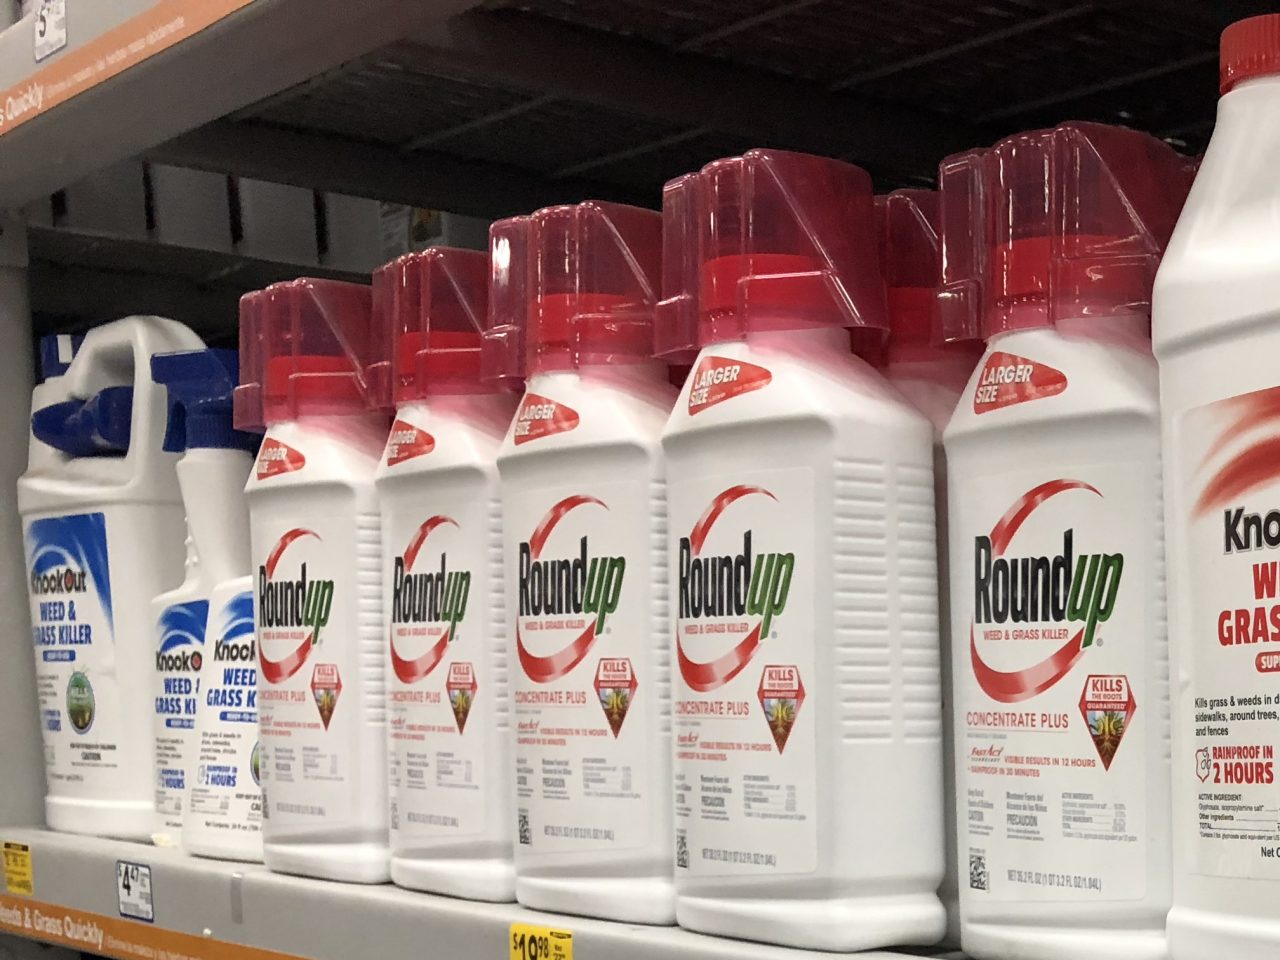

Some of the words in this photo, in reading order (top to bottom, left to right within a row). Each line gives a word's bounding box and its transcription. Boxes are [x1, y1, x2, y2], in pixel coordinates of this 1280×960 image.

[694, 364, 740, 390] LARGER
[982, 366, 1034, 386] LARGER
[690, 389, 709, 408] SIZE
[976, 386, 998, 404] SIZE
[519, 536, 626, 637] Roundup
[678, 530, 795, 641] Roundup
[975, 528, 1125, 650] Roundup
[258, 562, 335, 645] Roundup
[392, 552, 471, 642] Roundup
[40, 601, 65, 621] WEED
[68, 600, 76, 621] &
[983, 630, 1002, 641] WEED
[1004, 630, 1010, 640] &
[1012, 630, 1040, 640] GRASS
[1042, 629, 1068, 640] KILLER
[602, 661, 628, 673] KILLS
[768, 669, 794, 681] KILLS
[223, 668, 257, 686] WEED
[1092, 679, 1123, 692] KILLS
[163, 678, 192, 695] WEED
[206, 689, 243, 707] GRASS
[566, 691, 587, 705] PLUS
[1195, 697, 1208, 709] Kills
[1209, 698, 1228, 710] grass
[1230, 696, 1236, 707] &
[1237, 695, 1262, 706] weeds
[1264, 693, 1272, 705] in
[967, 711, 1036, 728] CONCENTRATE
[1040, 713, 1069, 729] PLUS
[1195, 711, 1228, 723] sidewalks,
[1230, 710, 1256, 721] around
[1257, 709, 1279, 721] trees,
[1195, 726, 1207, 736] and
[1207, 726, 1229, 736] fences
[1212, 746, 1261, 759] RAINPROOF
[1263, 745, 1273, 759] IN
[1213, 761, 1221, 784] 2
[1224, 761, 1274, 784] HOURS
[1260, 846, 1275, 858] Net
